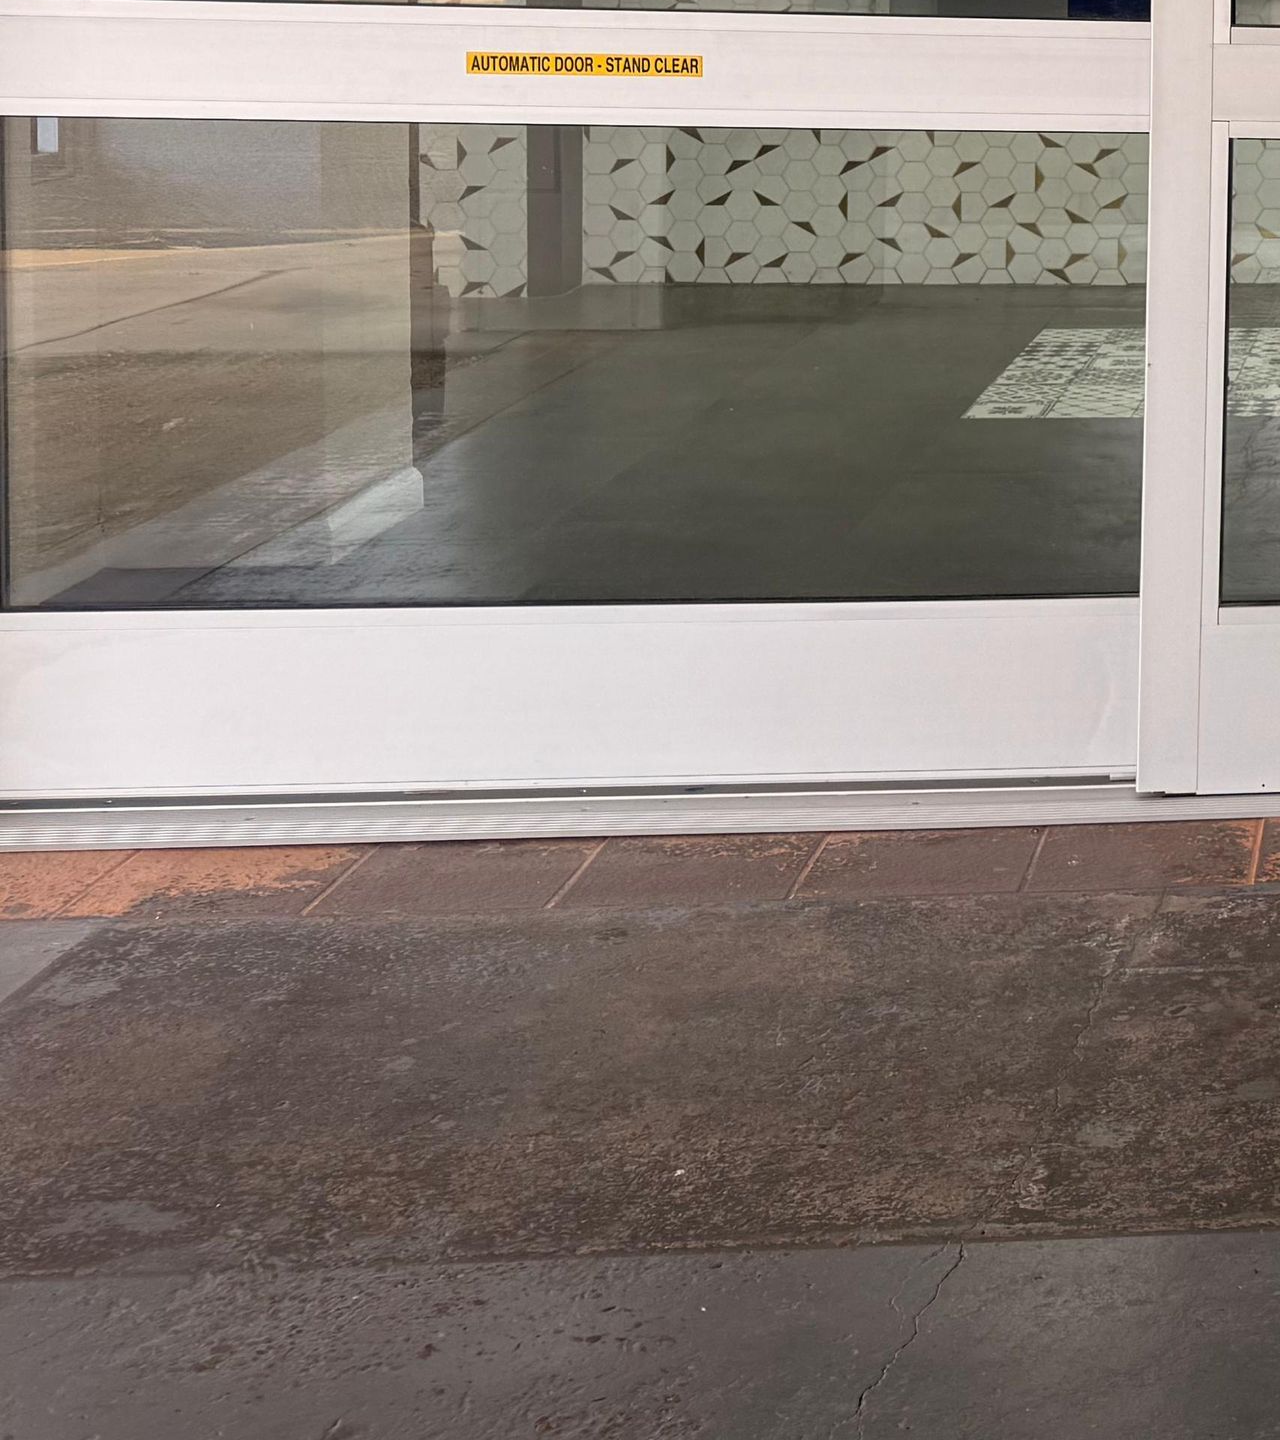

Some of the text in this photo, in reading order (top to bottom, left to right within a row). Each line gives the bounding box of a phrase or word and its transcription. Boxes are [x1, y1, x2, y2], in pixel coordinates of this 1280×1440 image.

[471, 55, 550, 72] AUTOMATIC
[555, 56, 593, 72] DOOR
[606, 58, 651, 73] STAND
[654, 58, 699, 74] CLEAR
